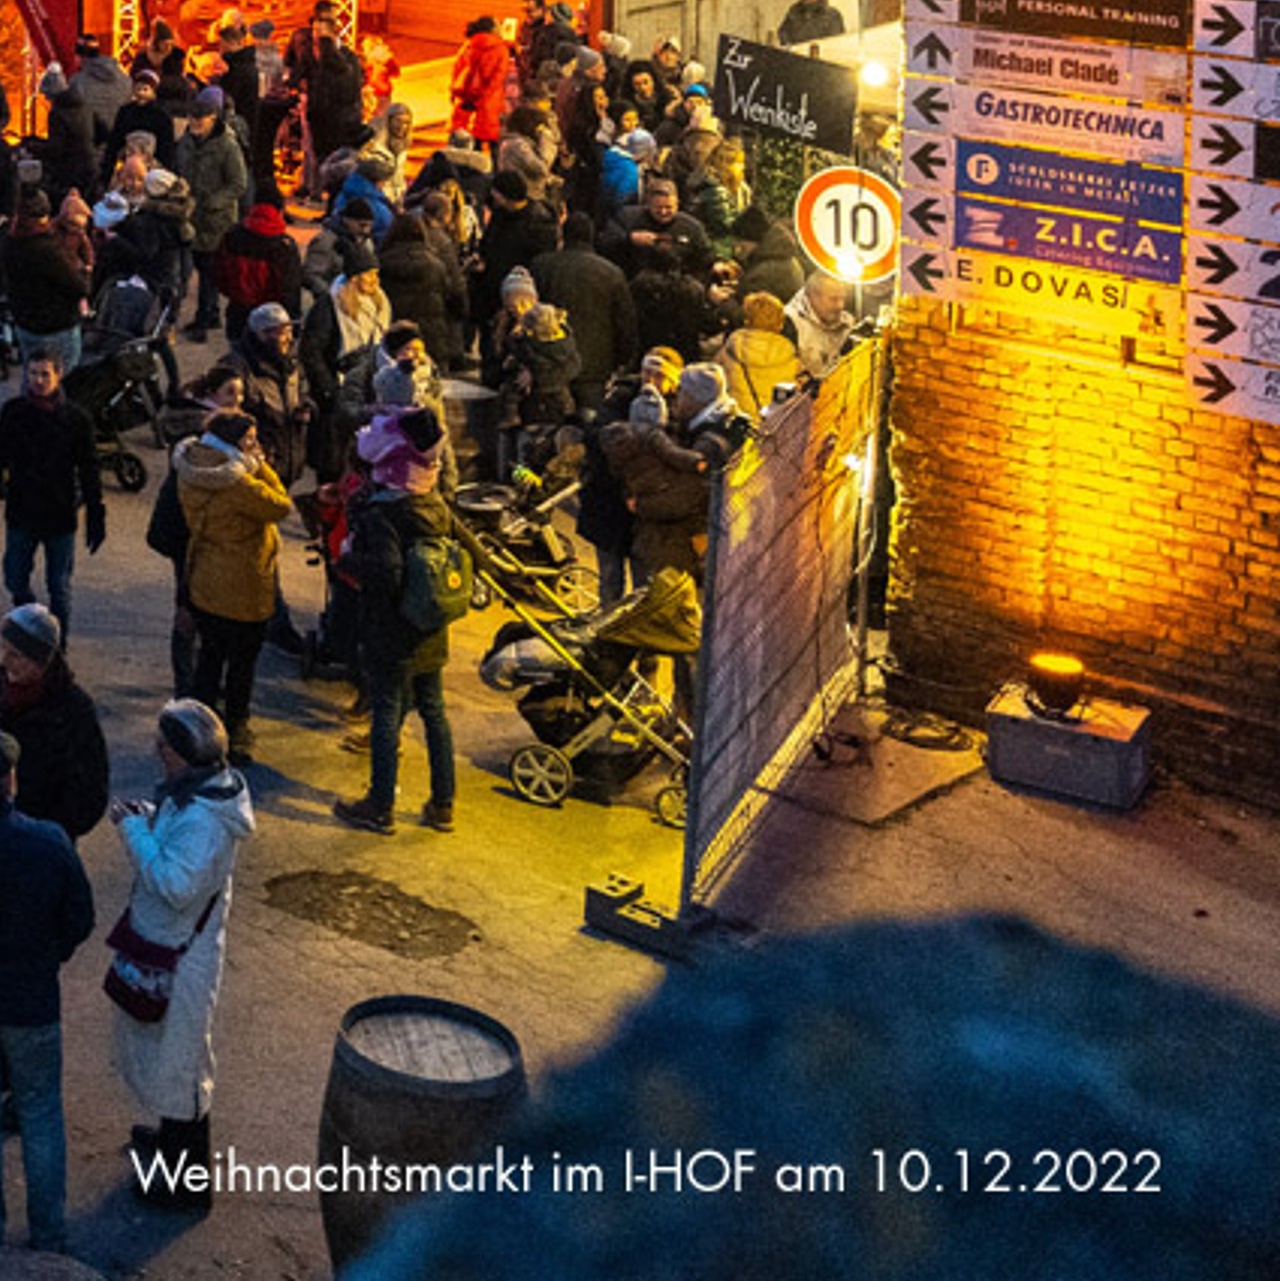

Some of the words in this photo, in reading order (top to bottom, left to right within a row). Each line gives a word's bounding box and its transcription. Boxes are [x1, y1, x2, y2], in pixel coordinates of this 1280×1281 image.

[1017, 0, 1096, 19] PERSONAL
[1102, 8, 1180, 29] TRAINING
[723, 38, 753, 69] Zur
[972, 47, 1054, 78] Michael
[725, 69, 818, 140] Weinkiste
[825, 198, 879, 251] 10
[1035, 216, 1171, 262] Z.I.C.A.
[957, 259, 983, 285] E.
